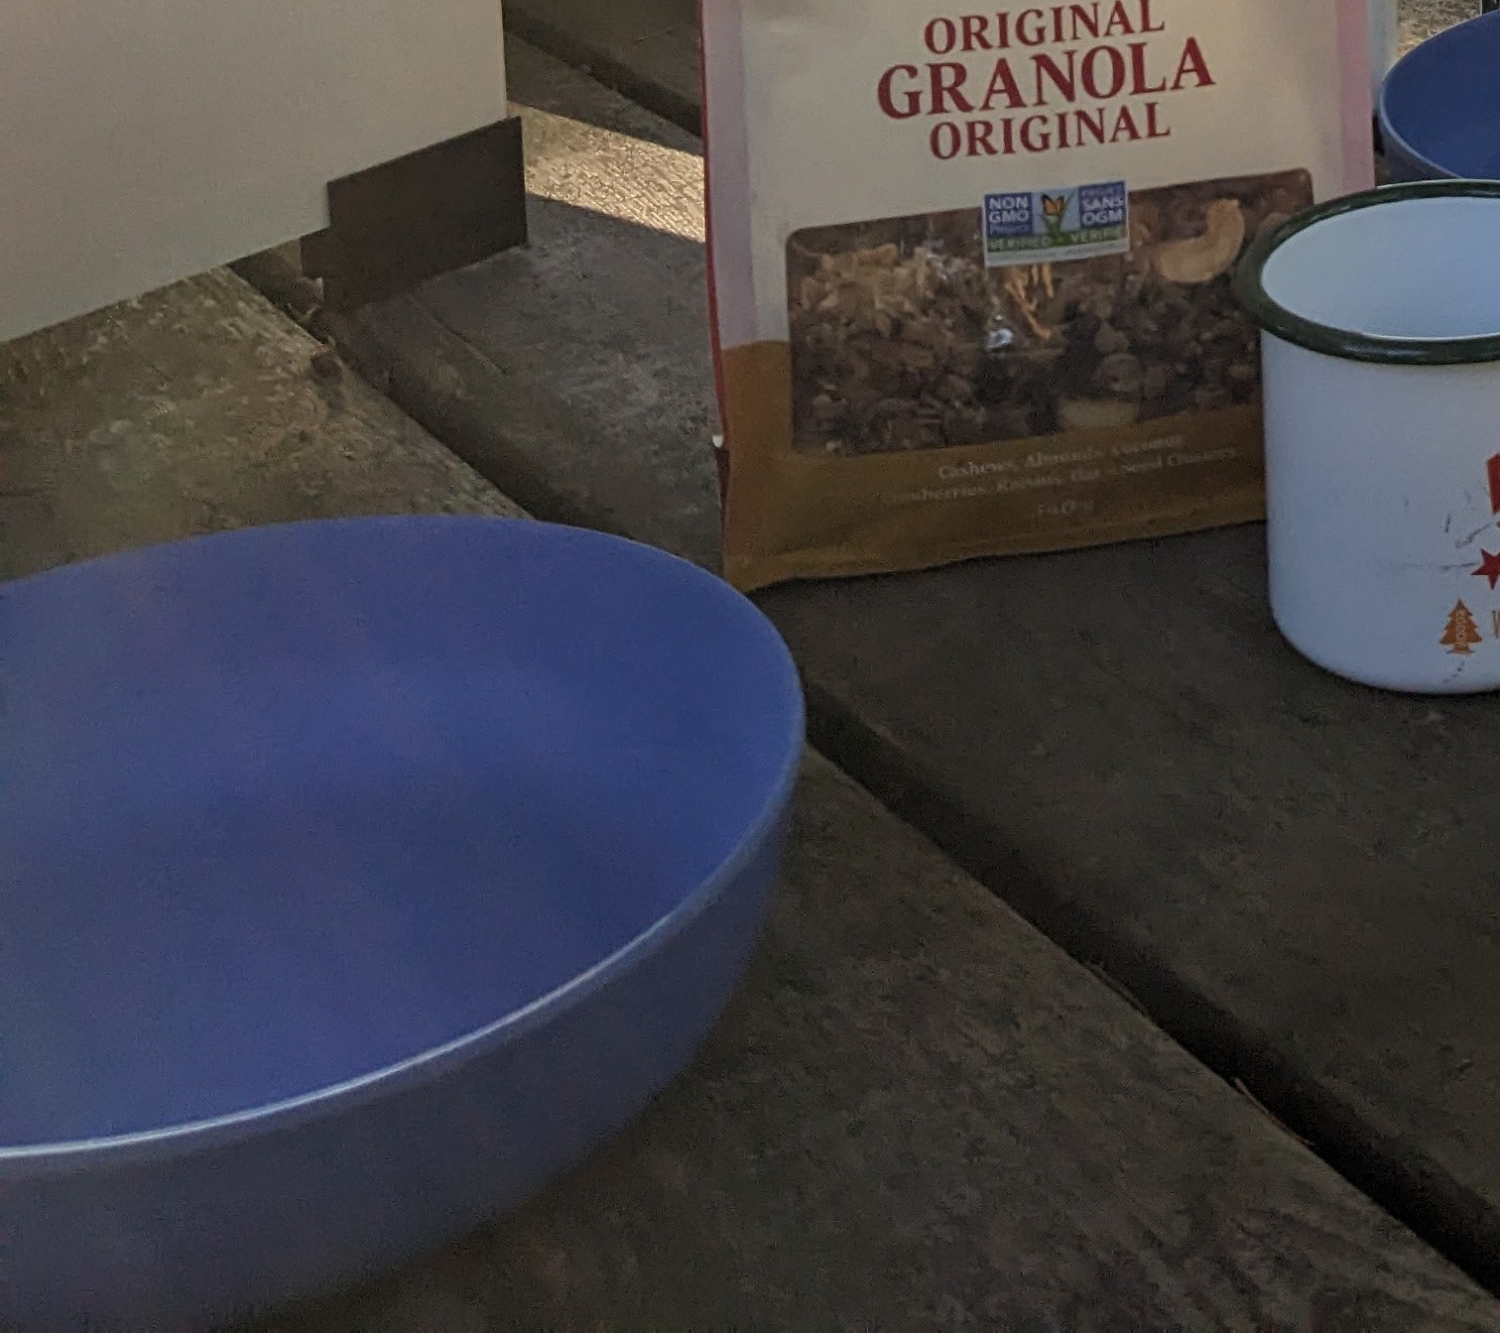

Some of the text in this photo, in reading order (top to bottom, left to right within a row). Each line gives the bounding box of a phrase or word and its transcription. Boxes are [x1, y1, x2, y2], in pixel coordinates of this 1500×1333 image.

[877, 36, 1217, 120] GRANOLA
[929, 101, 1171, 161] ORIGINAL
[988, 195, 1029, 210] NON
[988, 209, 1030, 224] GMO
[1081, 209, 1124, 226] OGM
